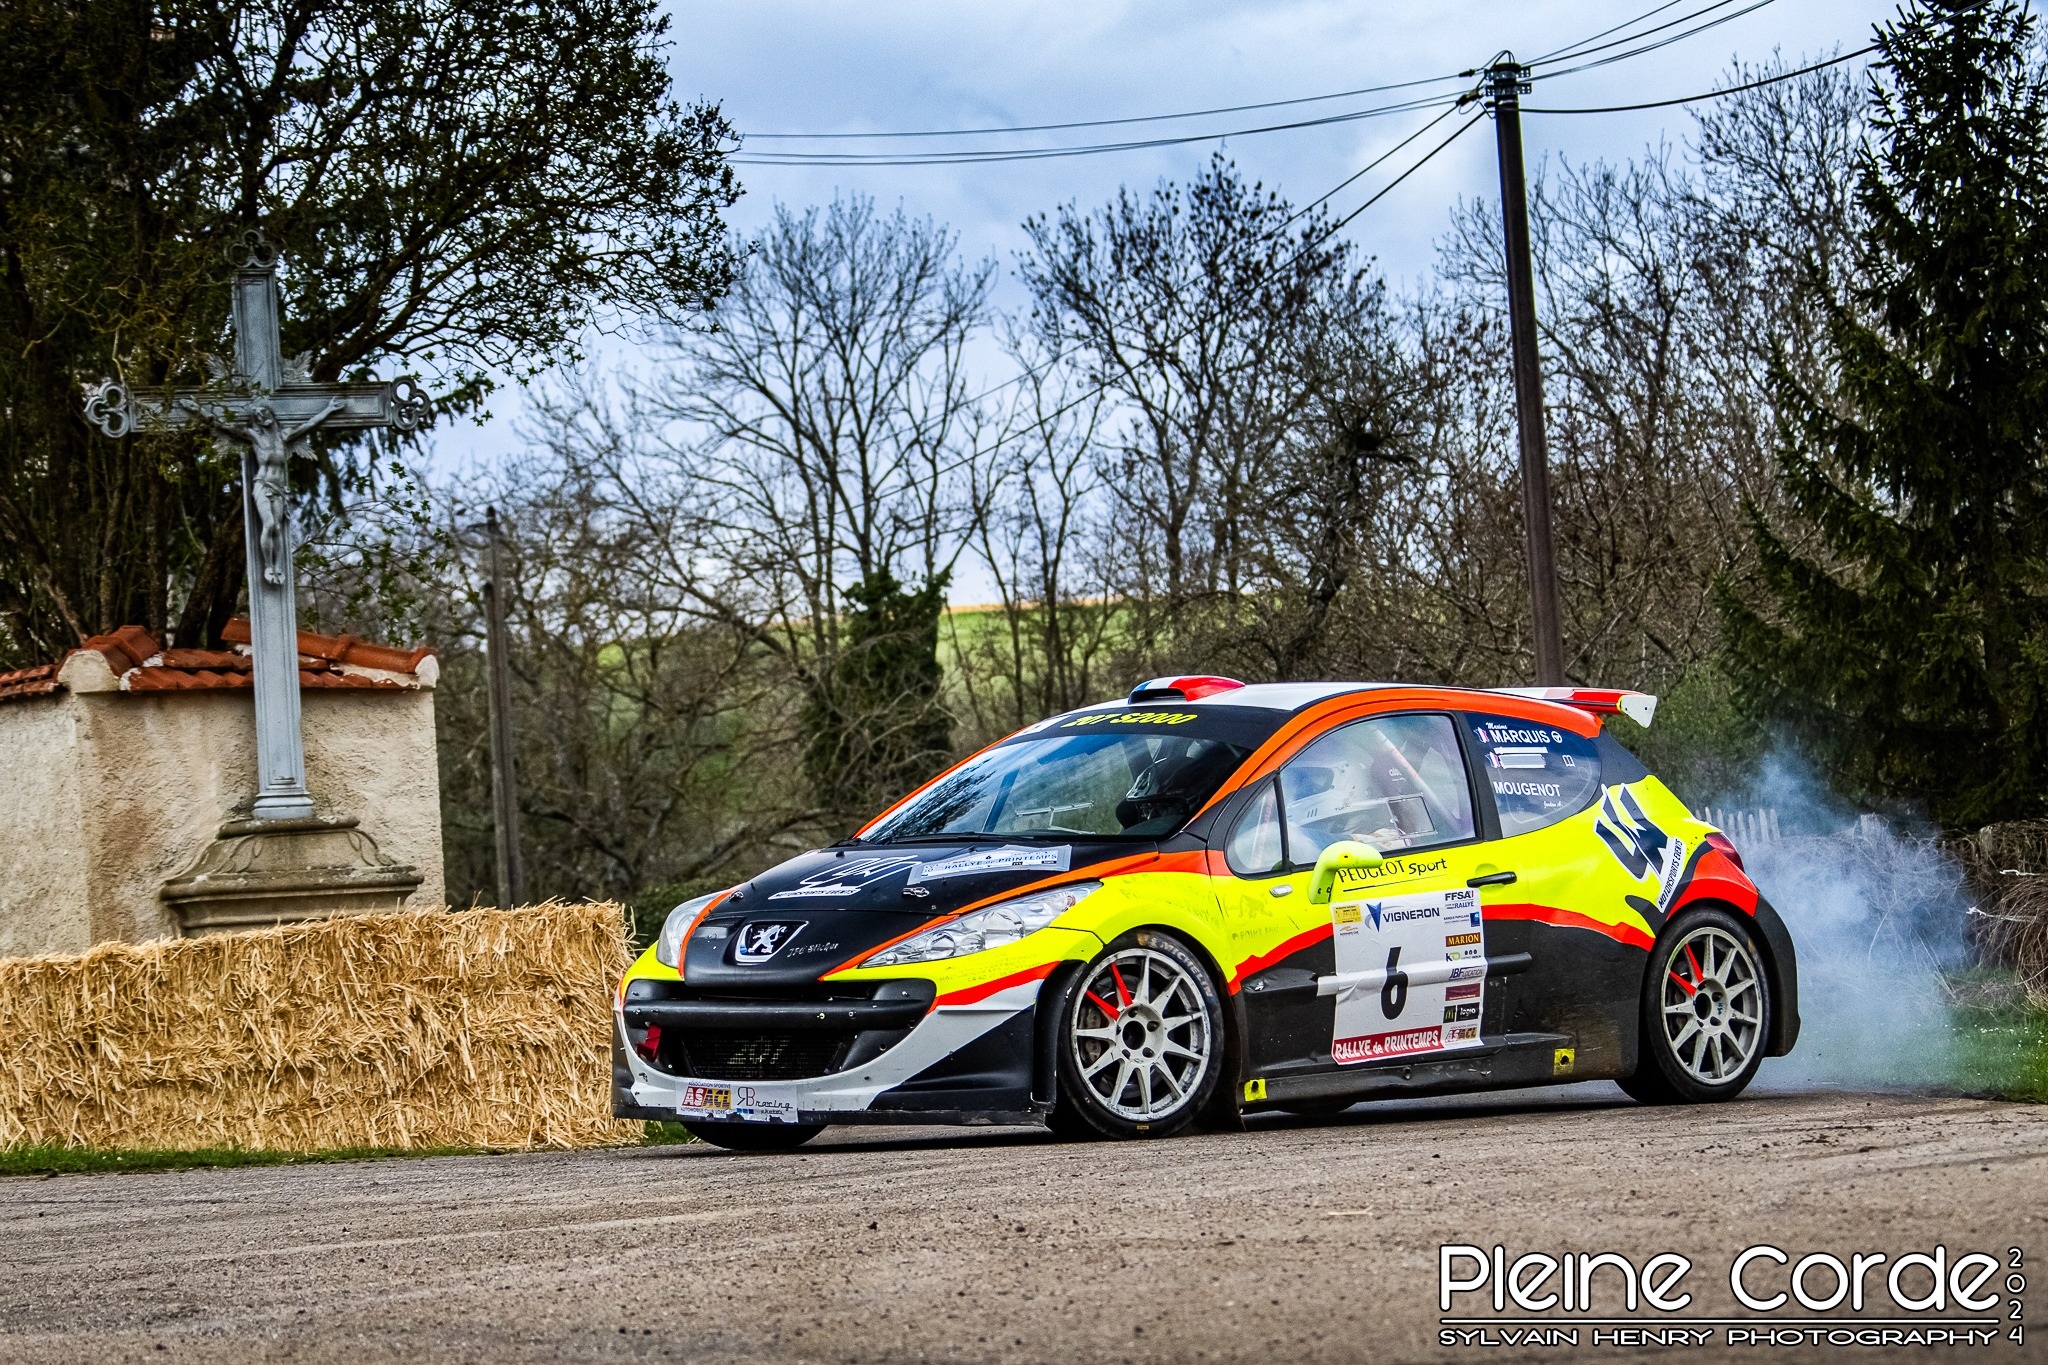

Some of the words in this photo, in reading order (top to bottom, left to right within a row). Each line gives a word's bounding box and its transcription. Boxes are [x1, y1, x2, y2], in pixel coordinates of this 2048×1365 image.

[1489, 730, 1551, 744] MARQUIS
[1493, 781, 1560, 797] MOUGENOT
[944, 860, 982, 870] RALLYE
[998, 854, 1057, 863] PRINTEMPS
[1337, 860, 1404, 883] PEUGEOT
[1658, 858, 1679, 908] MOTORSPORTS
[1445, 890, 1471, 901] FFSA
[1454, 901, 1474, 909] RALLYE
[1382, 907, 1440, 923] VIGNERON
[1448, 934, 1479, 945] MARION
[1160, 941, 1213, 997] MICHELIN
[1381, 946, 1408, 1020] 6
[1334, 1040, 1373, 1060] RALLYE
[1372, 1041, 1384, 1055] de
[1384, 1030, 1439, 1053] PRINTEMPS
